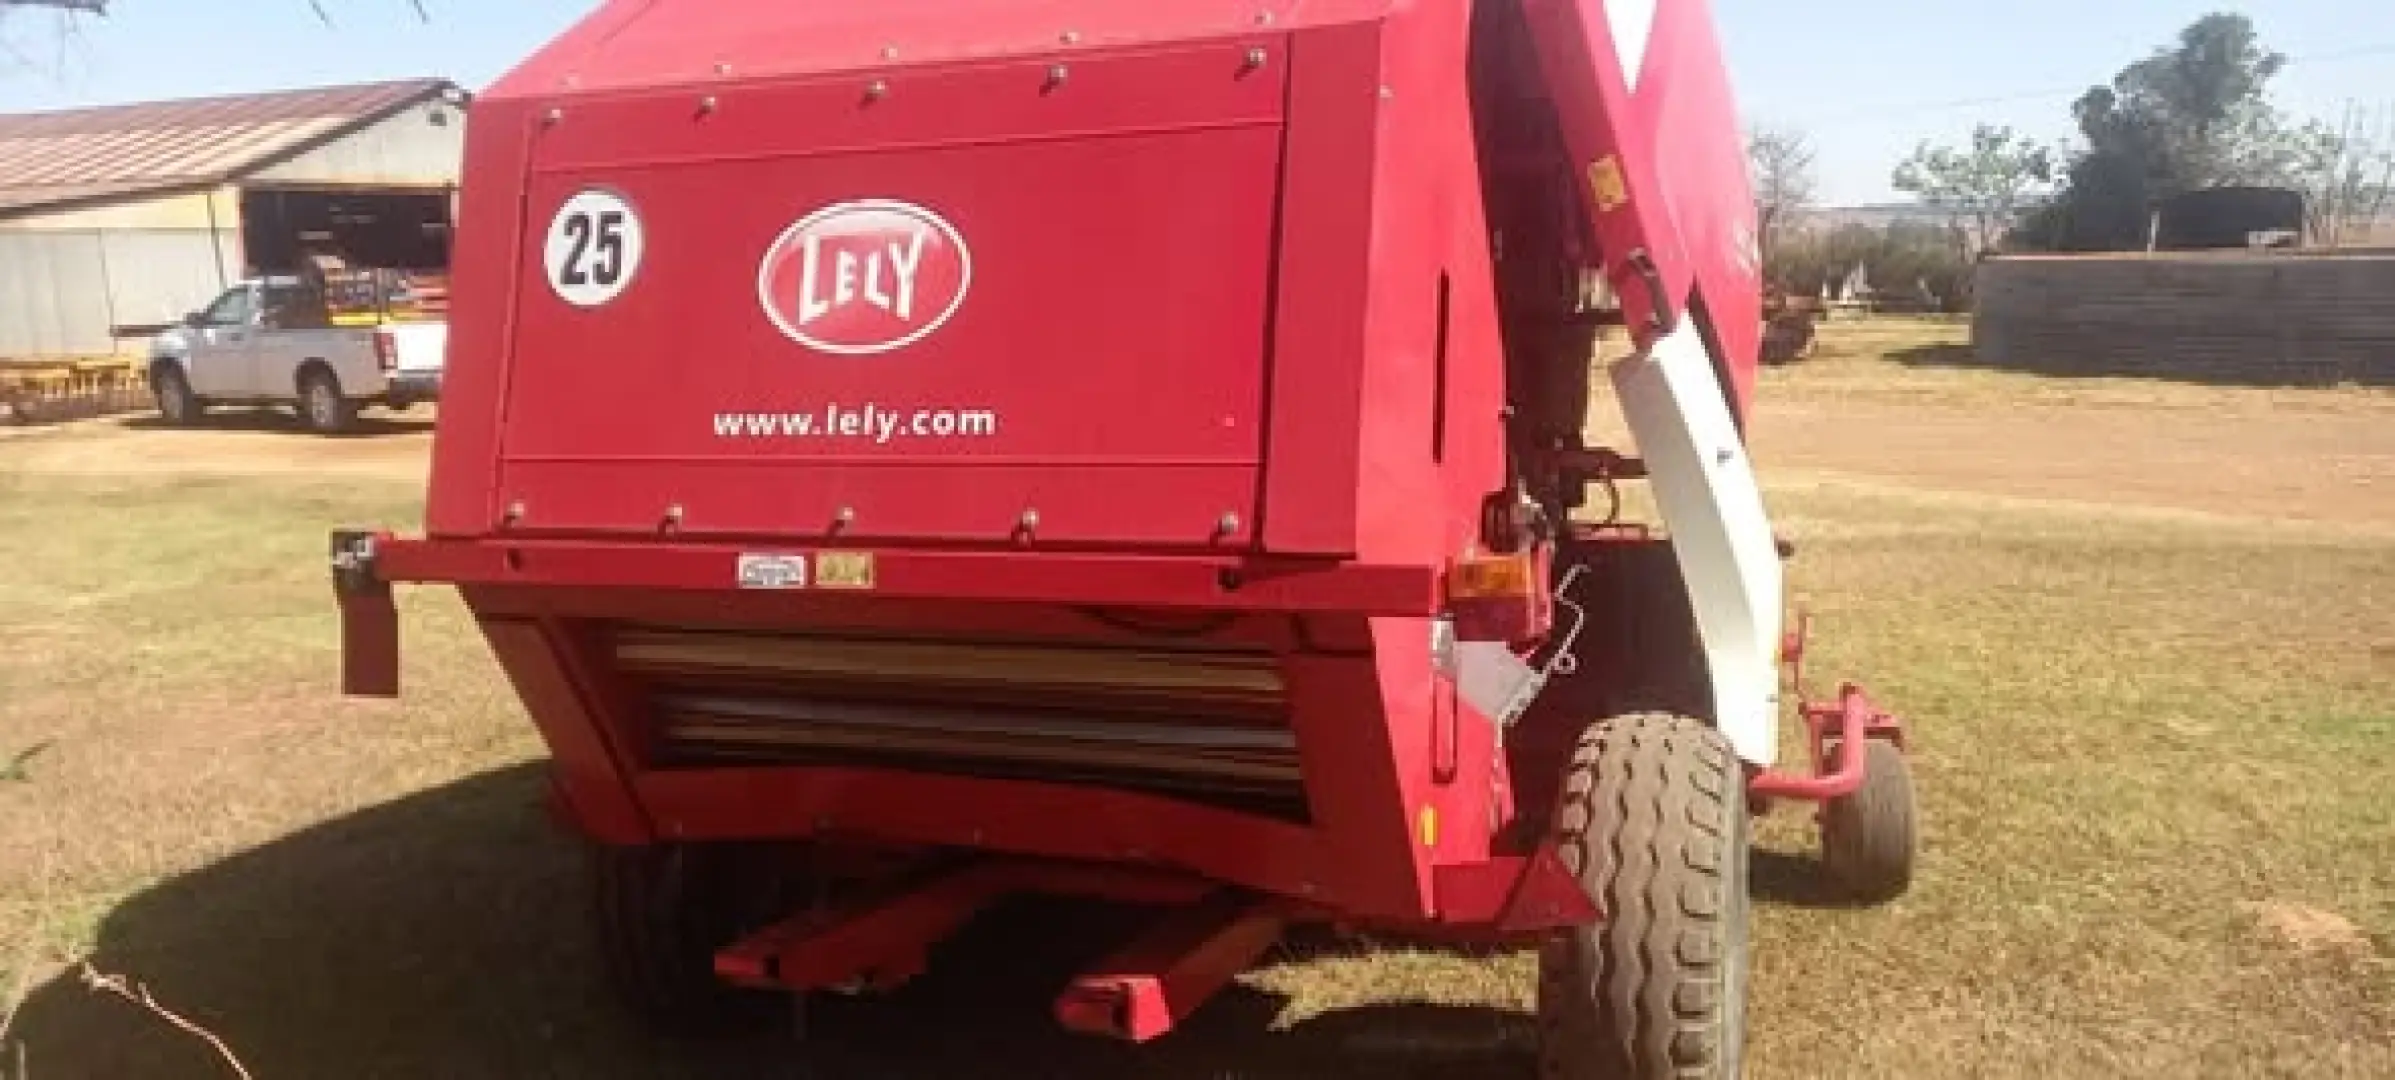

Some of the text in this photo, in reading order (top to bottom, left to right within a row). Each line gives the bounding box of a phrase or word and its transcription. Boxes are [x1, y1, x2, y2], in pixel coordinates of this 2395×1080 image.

[560, 212, 624, 285] 25
[799, 227, 927, 325] LELY
[713, 403, 995, 443] www.lely.com
